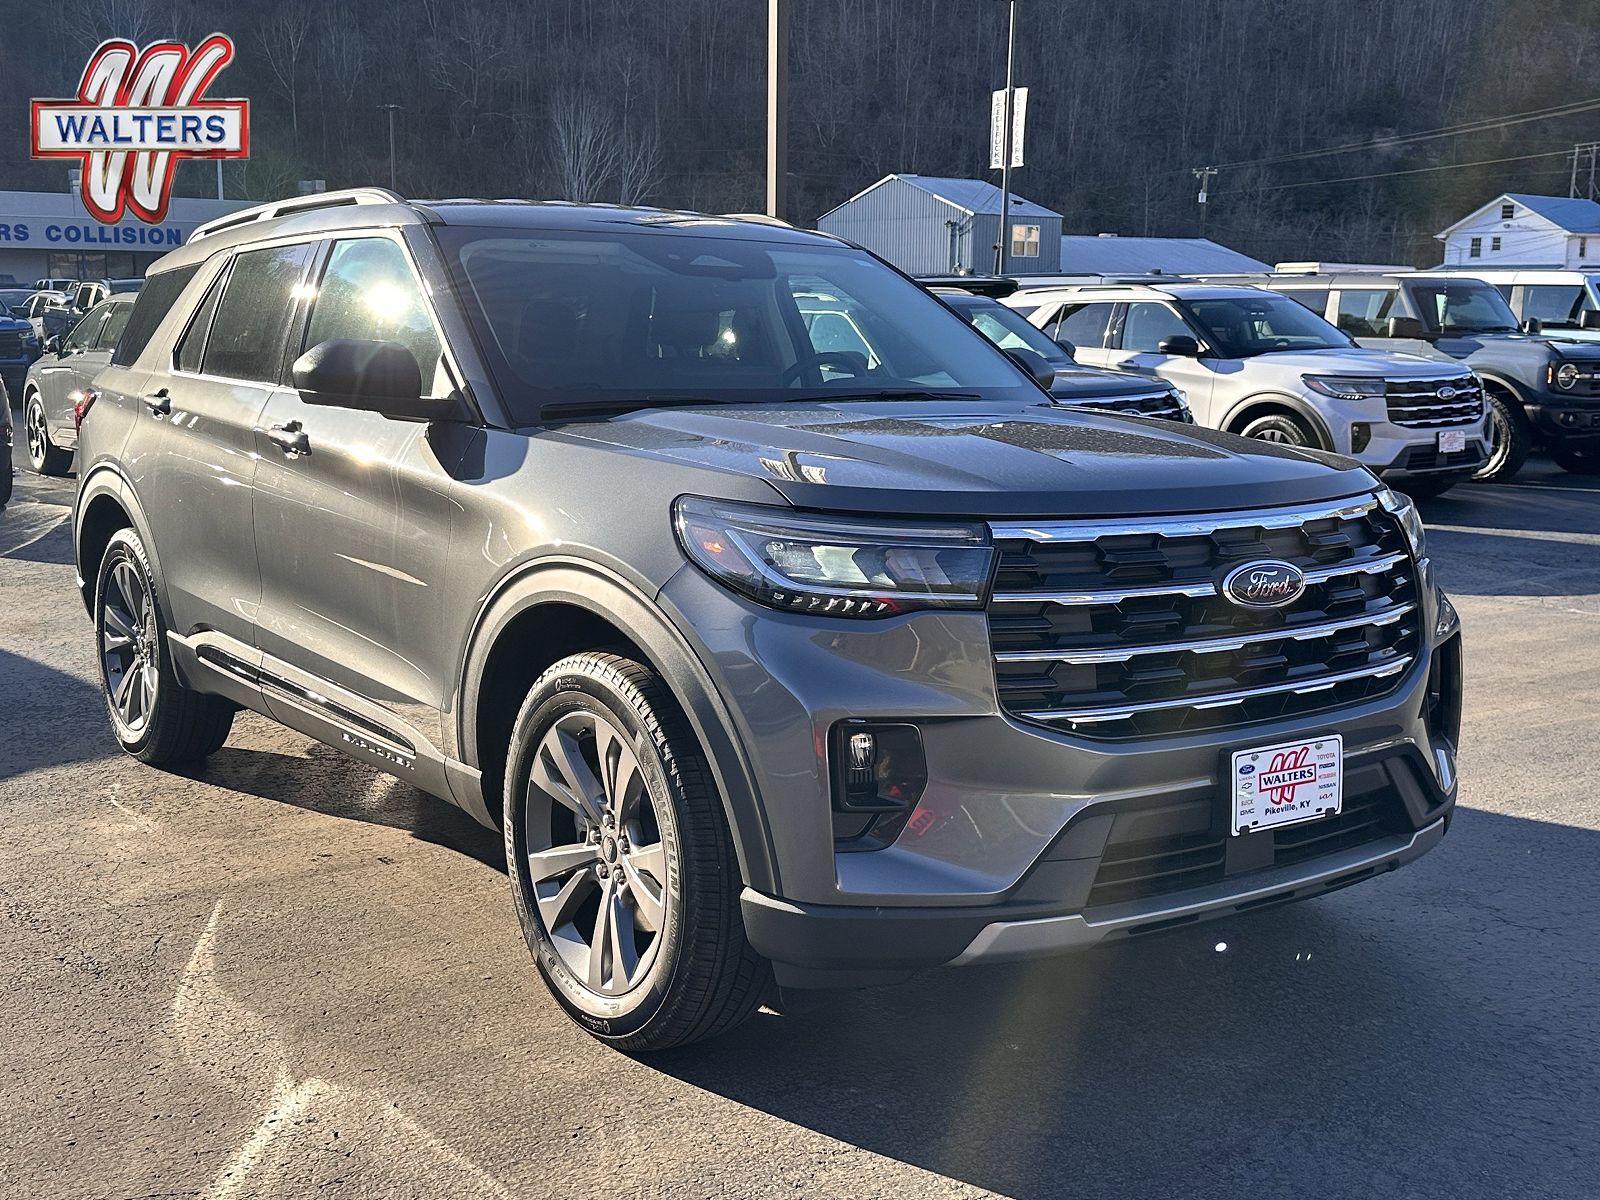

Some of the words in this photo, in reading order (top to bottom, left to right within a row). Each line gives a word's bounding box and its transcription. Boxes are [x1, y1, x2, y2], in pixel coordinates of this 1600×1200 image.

[45, 224, 182, 246] COLLISION
[1247, 570, 1294, 599] Ford
[1316, 752, 1336, 760] TOYOTA
[1263, 768, 1313, 786] WALTERS
[1299, 800, 1311, 809] KY
[1240, 808, 1255, 816] GMC
